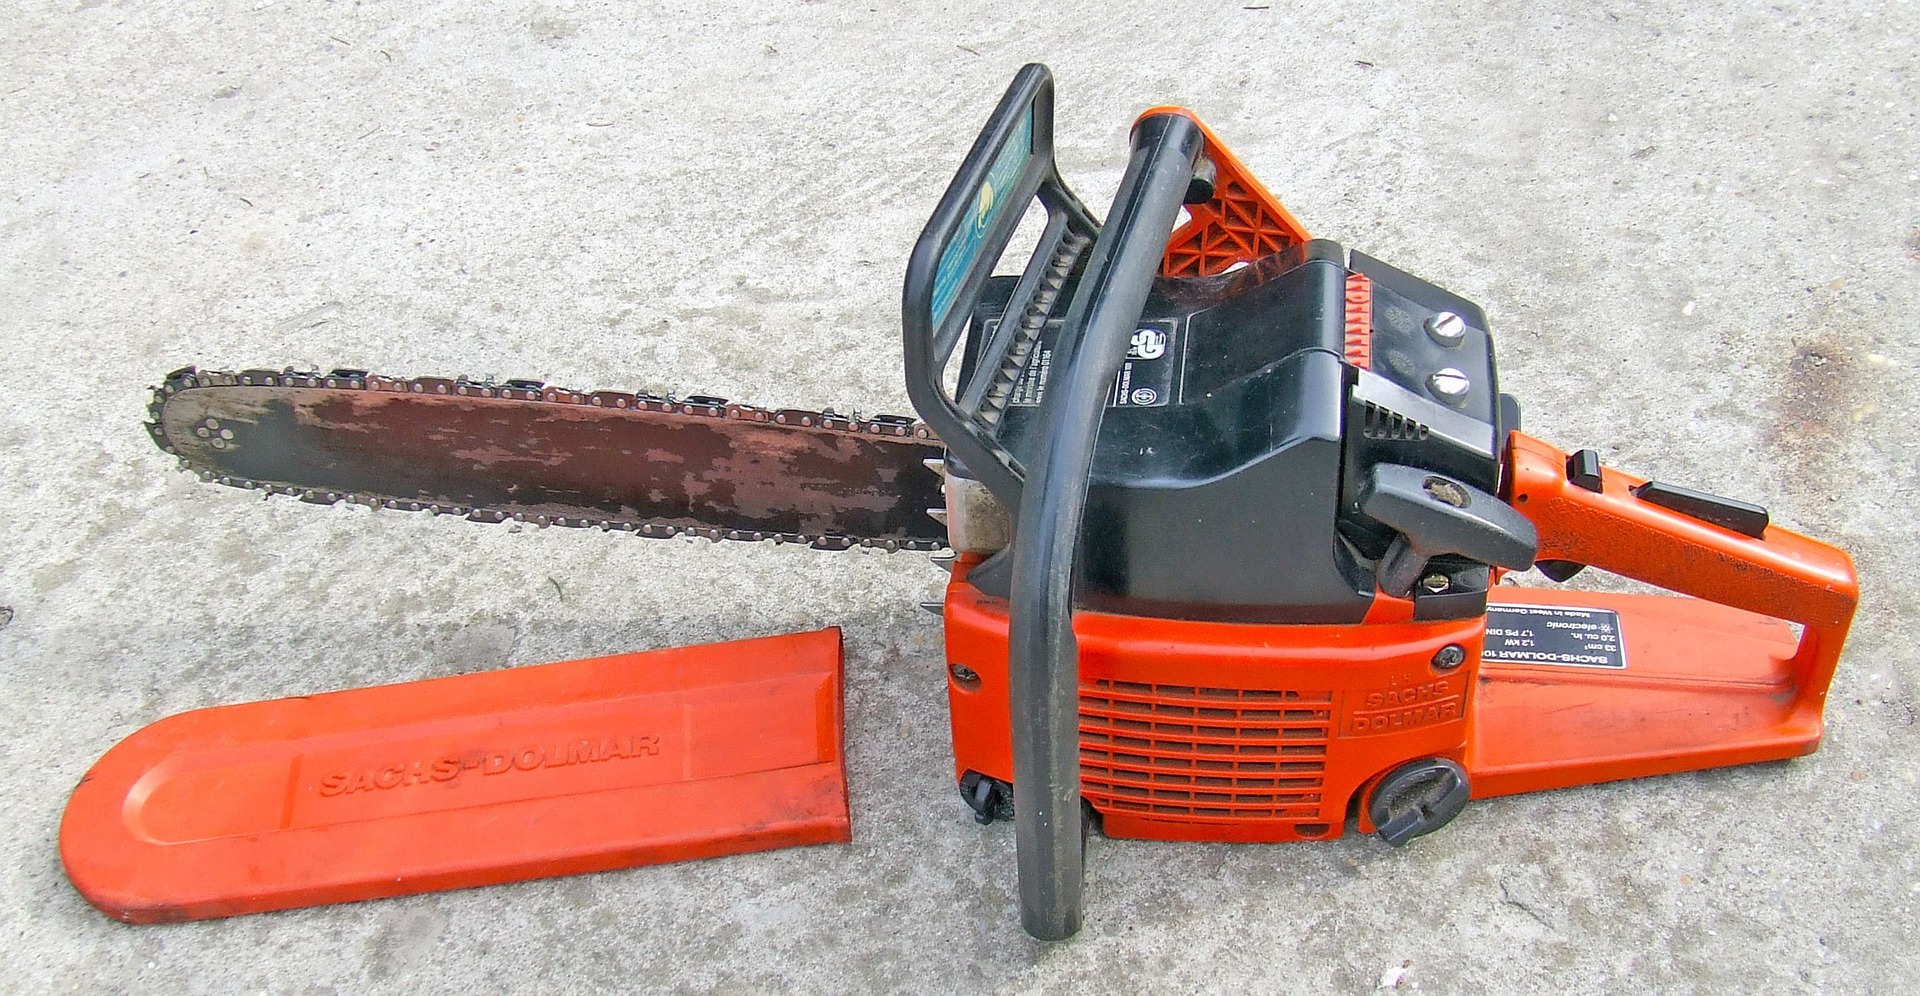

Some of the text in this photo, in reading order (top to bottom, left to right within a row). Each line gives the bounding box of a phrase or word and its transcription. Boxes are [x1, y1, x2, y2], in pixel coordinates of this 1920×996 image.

[1486, 606, 1528, 615] Germany
[1527, 608, 1552, 616] West
[1546, 621, 1598, 631] electronic
[1485, 628, 1503, 636] DIN
[1504, 628, 1519, 637] PS
[1504, 638, 1521, 647] kW
[1604, 643, 1617, 652] 33
[1499, 650, 1608, 663] SACHS-DOLMAR
[1365, 681, 1449, 706] SACHS
[1350, 702, 1457, 732] DOLMAR
[320, 735, 661, 798] SACHS-DOLMAR
